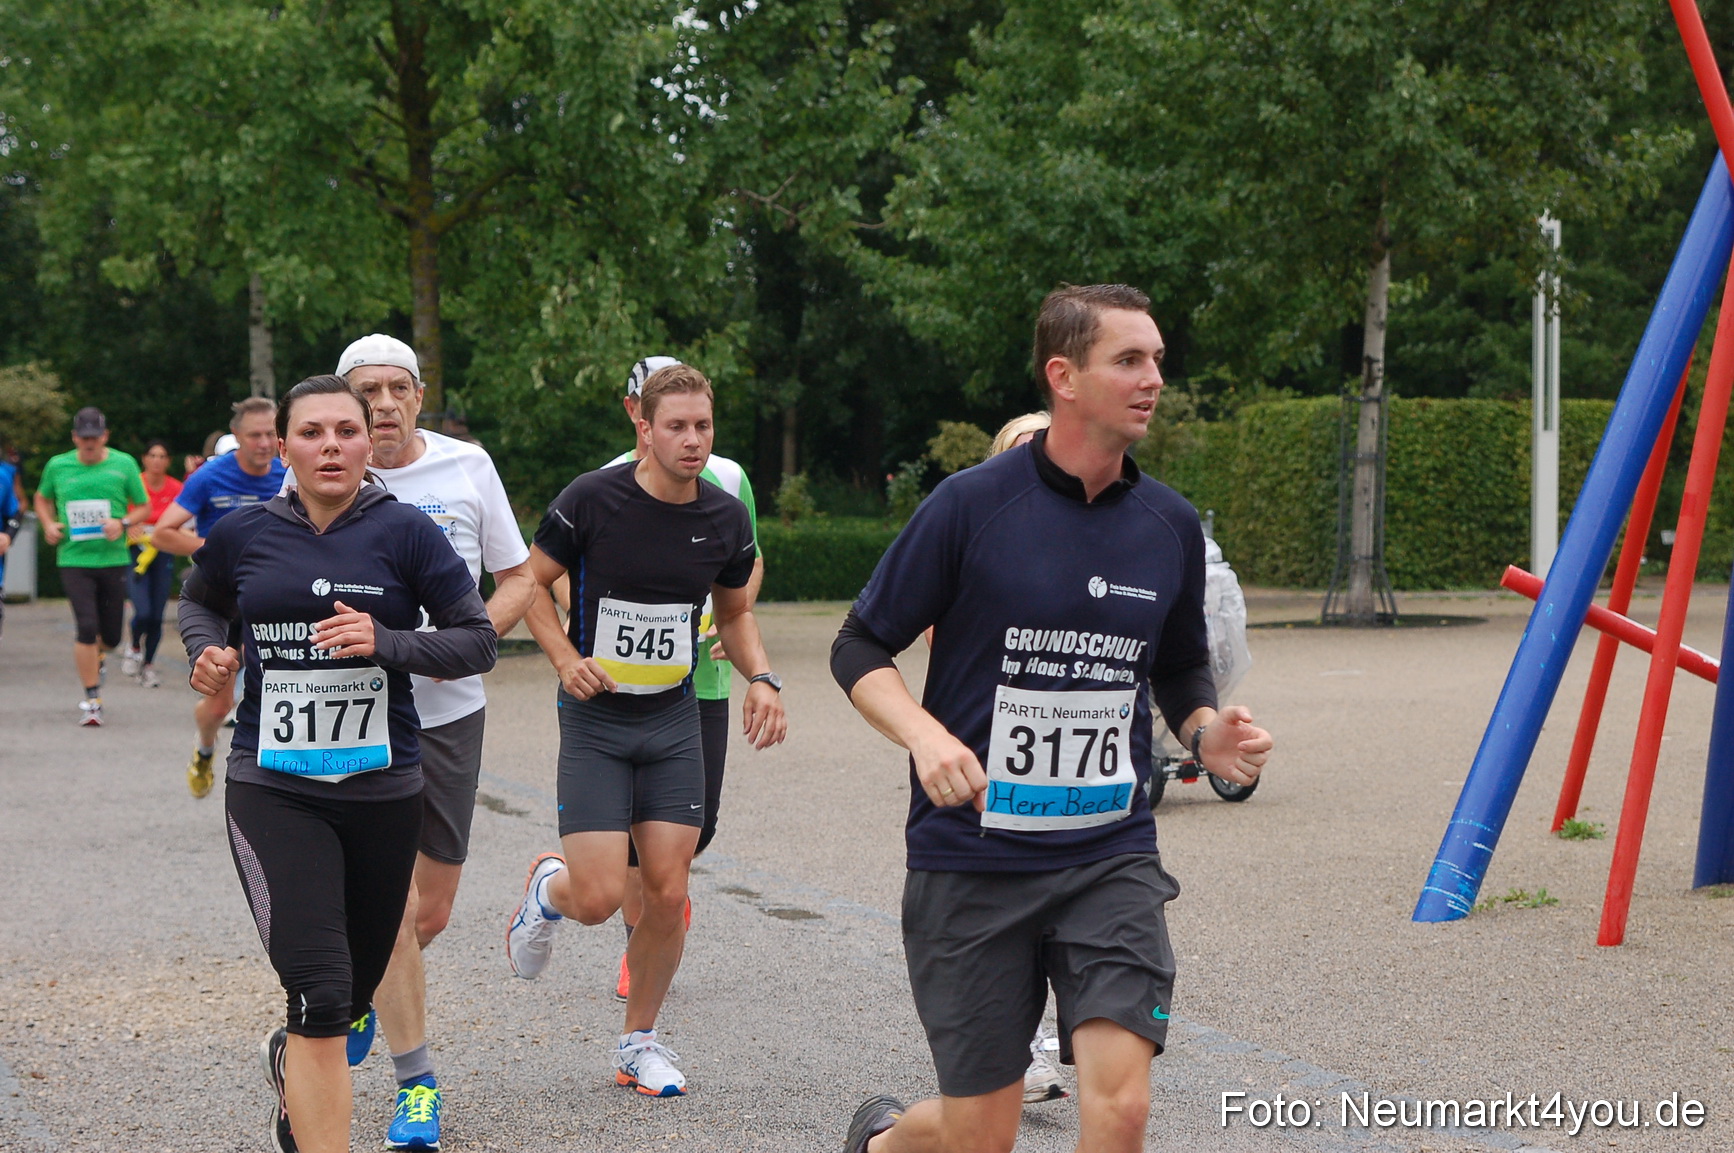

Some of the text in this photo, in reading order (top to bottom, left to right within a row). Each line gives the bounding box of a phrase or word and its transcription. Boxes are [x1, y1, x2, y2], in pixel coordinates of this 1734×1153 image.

[600, 606, 678, 623] PARTL Neumarkt
[251, 622, 318, 642] GRUNDS
[615, 624, 675, 661] 545
[273, 645, 305, 661] Haus
[1001, 655, 1021, 675] im
[1025, 656, 1068, 678] Haus
[265, 681, 365, 694] PARTL Neumarkt
[273, 697, 376, 743] 3177
[998, 701, 1115, 719] PARTL Neumarkt
[272, 751, 369, 774] Frau Rupp
[1005, 725, 1120, 778] 3176
[989, 781, 1127, 817] Herr Beck
